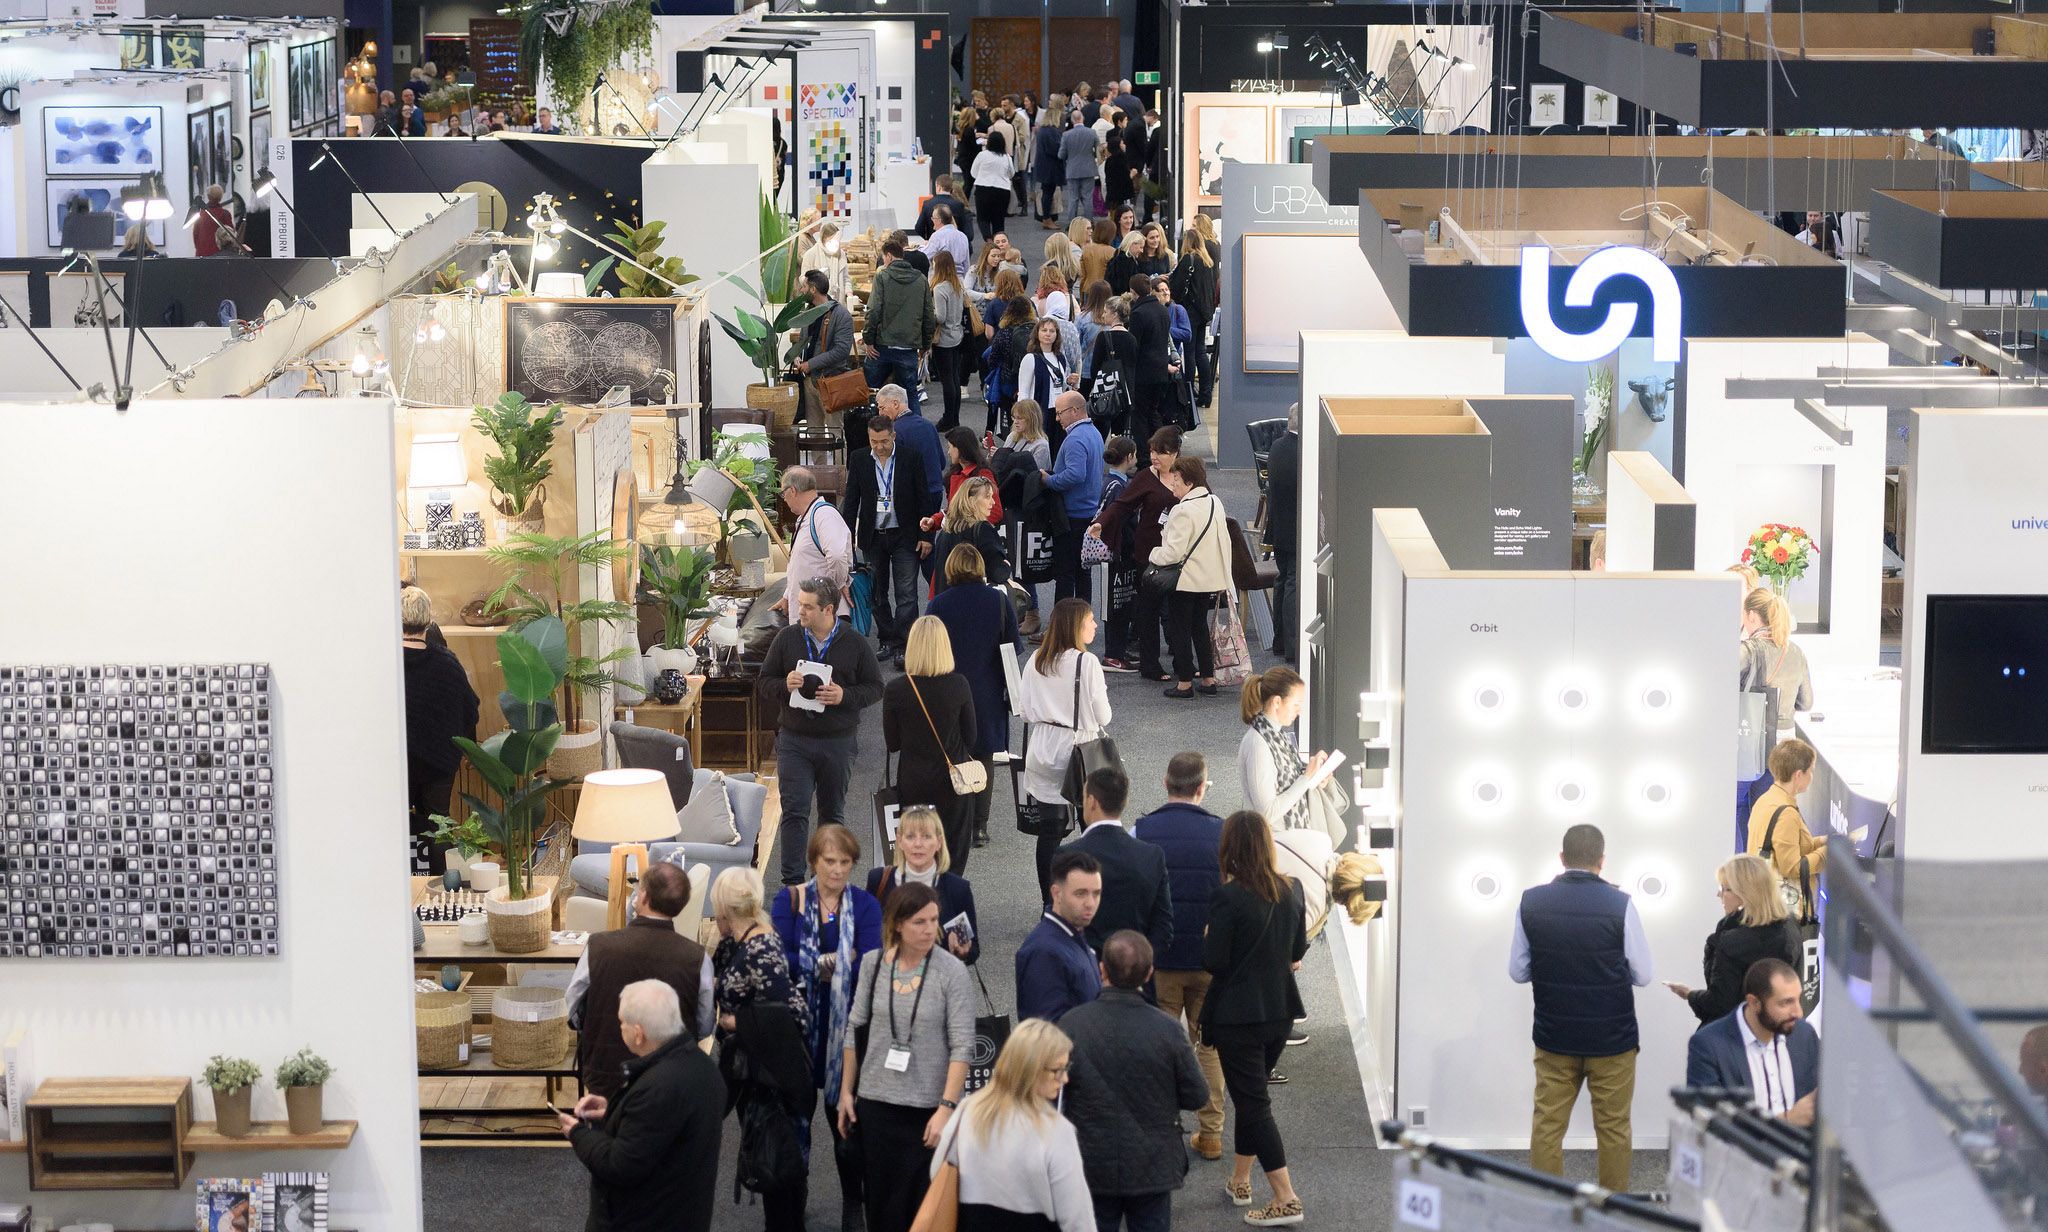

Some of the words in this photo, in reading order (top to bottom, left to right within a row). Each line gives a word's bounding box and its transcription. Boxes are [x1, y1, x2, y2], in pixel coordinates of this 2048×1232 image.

[803, 107, 855, 119] SPECTRUM
[276, 144, 285, 161] C26
[278, 211, 287, 252] HEPBURN
[1494, 508, 1521, 517] Vanity
[1470, 623, 1498, 632] Orbit
[8, 1061, 16, 1087] HOME
[10, 1098, 20, 1128] LIVING
[1406, 1192, 1433, 1218] 40
